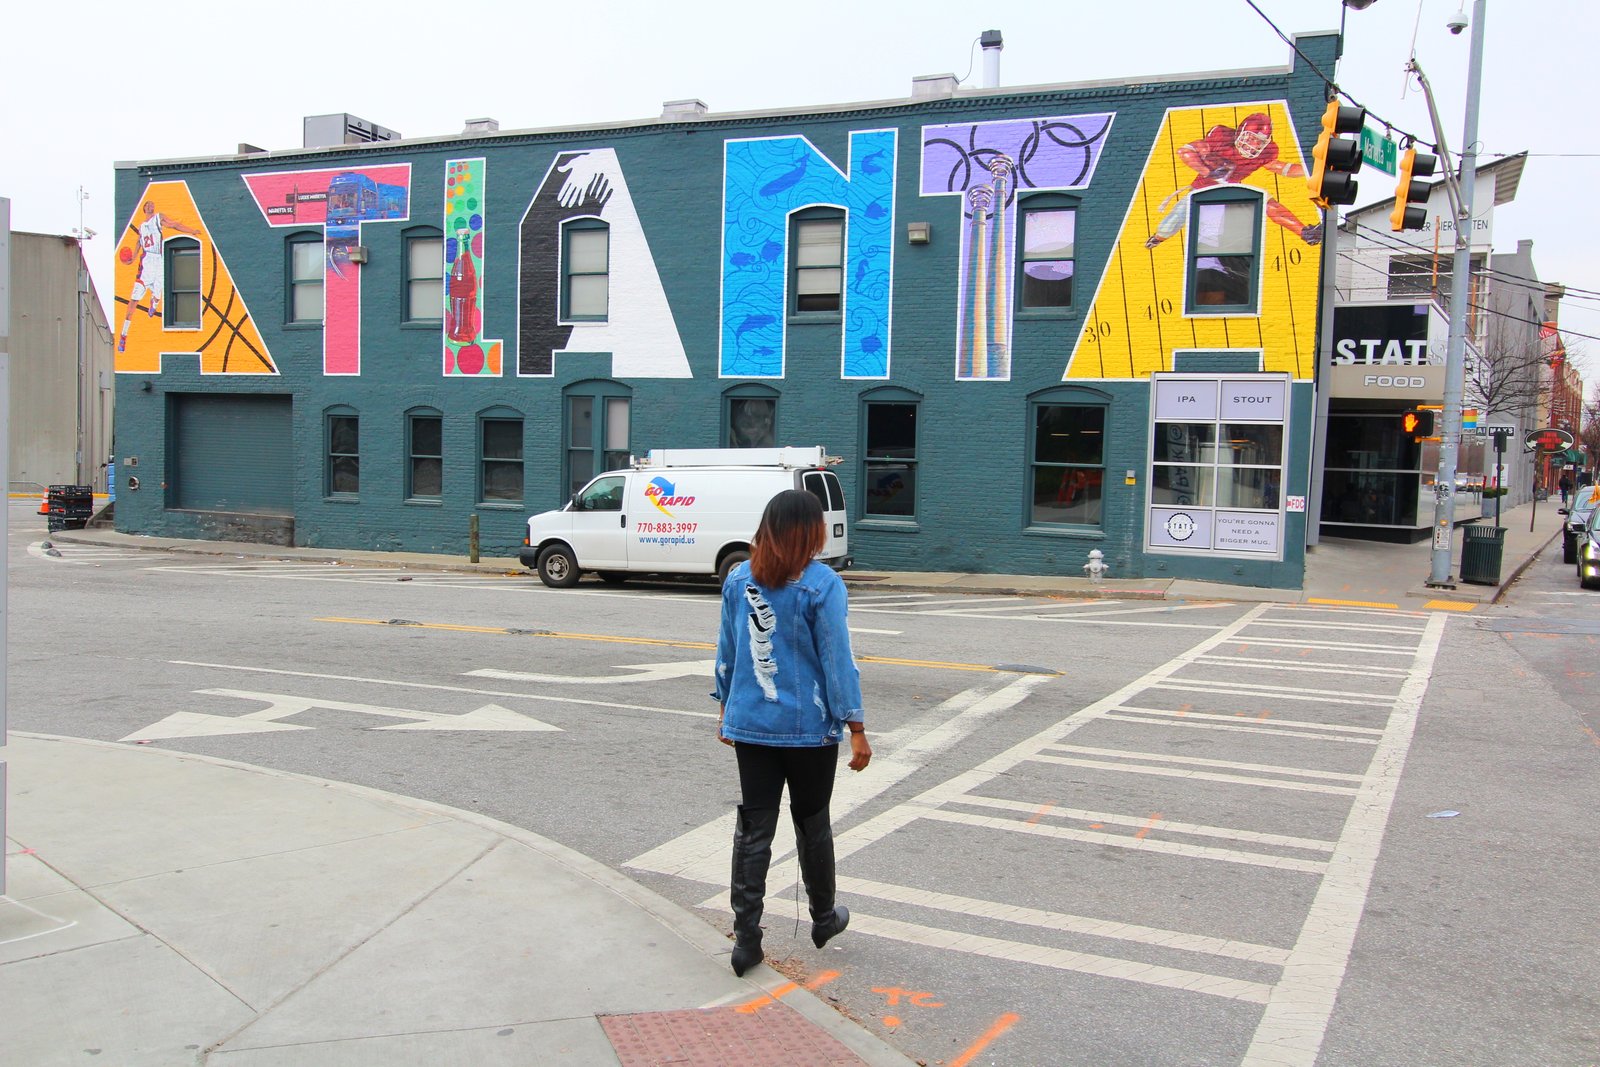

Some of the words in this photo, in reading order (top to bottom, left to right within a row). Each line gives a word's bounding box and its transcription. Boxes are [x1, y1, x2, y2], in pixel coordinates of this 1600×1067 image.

[114, 98, 1316, 382] ATLANTA
[144, 234, 154, 248] 21
[1336, 339, 1446, 366] STATS
[1364, 376, 1425, 388] FOOD
[644, 487, 663, 496] GO
[657, 496, 696, 506] RAPID
[1292, 498, 1304, 509] FDC
[637, 523, 698, 533] 770-883-3997
[639, 535, 695, 546] www.gorapid.us
